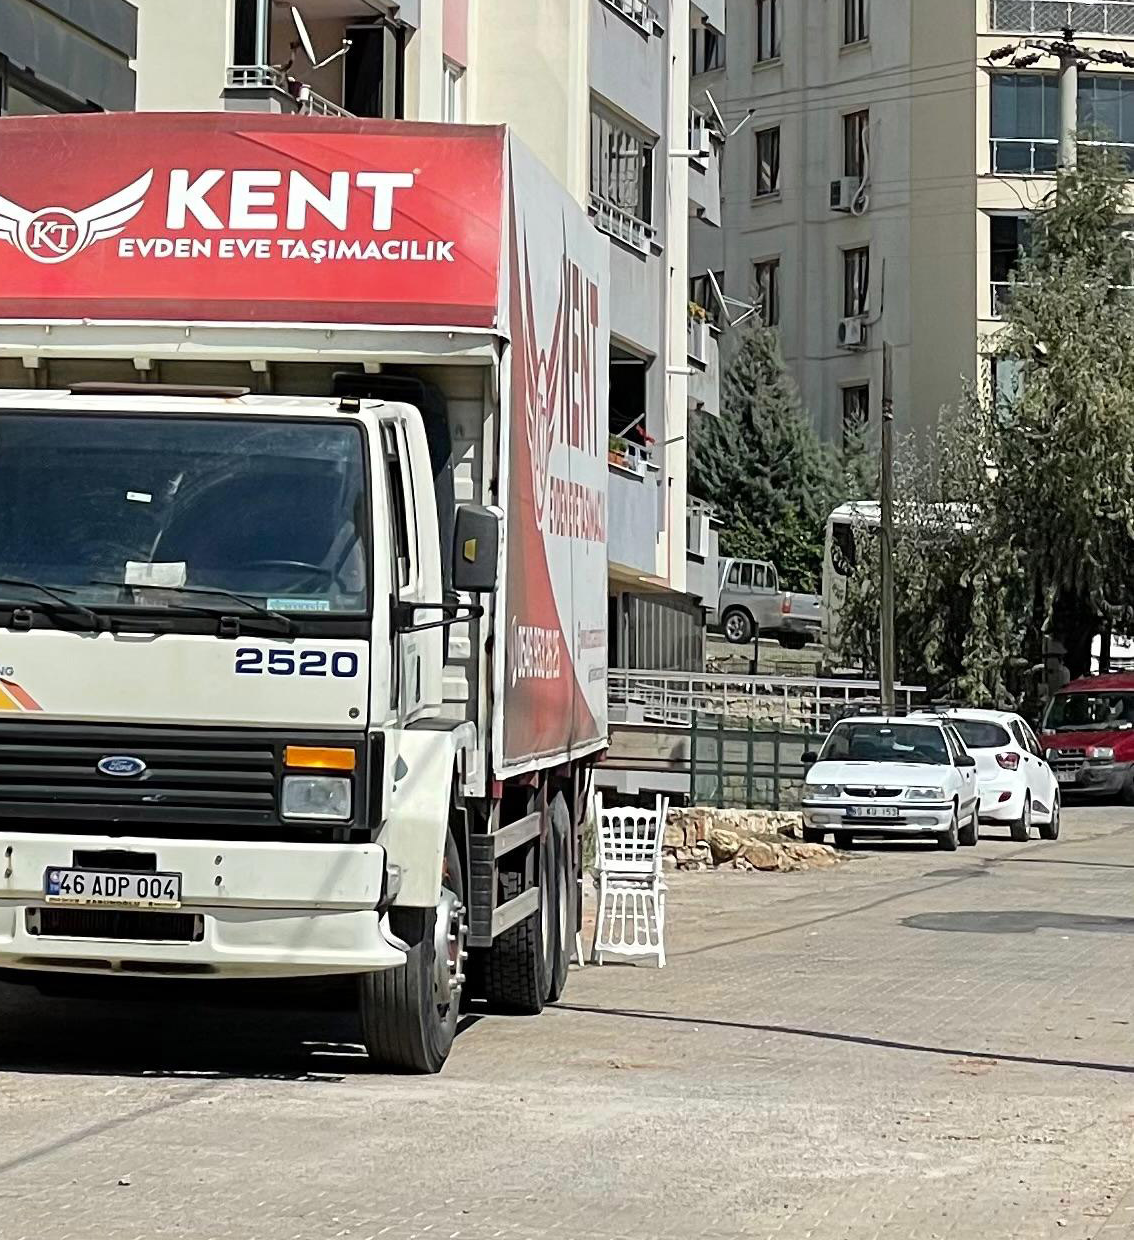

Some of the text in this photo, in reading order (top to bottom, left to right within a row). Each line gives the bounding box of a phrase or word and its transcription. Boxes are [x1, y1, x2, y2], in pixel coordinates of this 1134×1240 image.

[166, 168, 414, 231] KENT
[30, 221, 76, 254] KT
[118, 237, 455, 264] EVDEN EVE TAŞIMACILIK
[235, 647, 359, 678] 2520
[108, 759, 134, 772] Ford
[60, 873, 85, 895] 46
[92, 875, 130, 897] ADP
[137, 877, 175, 900] 004
